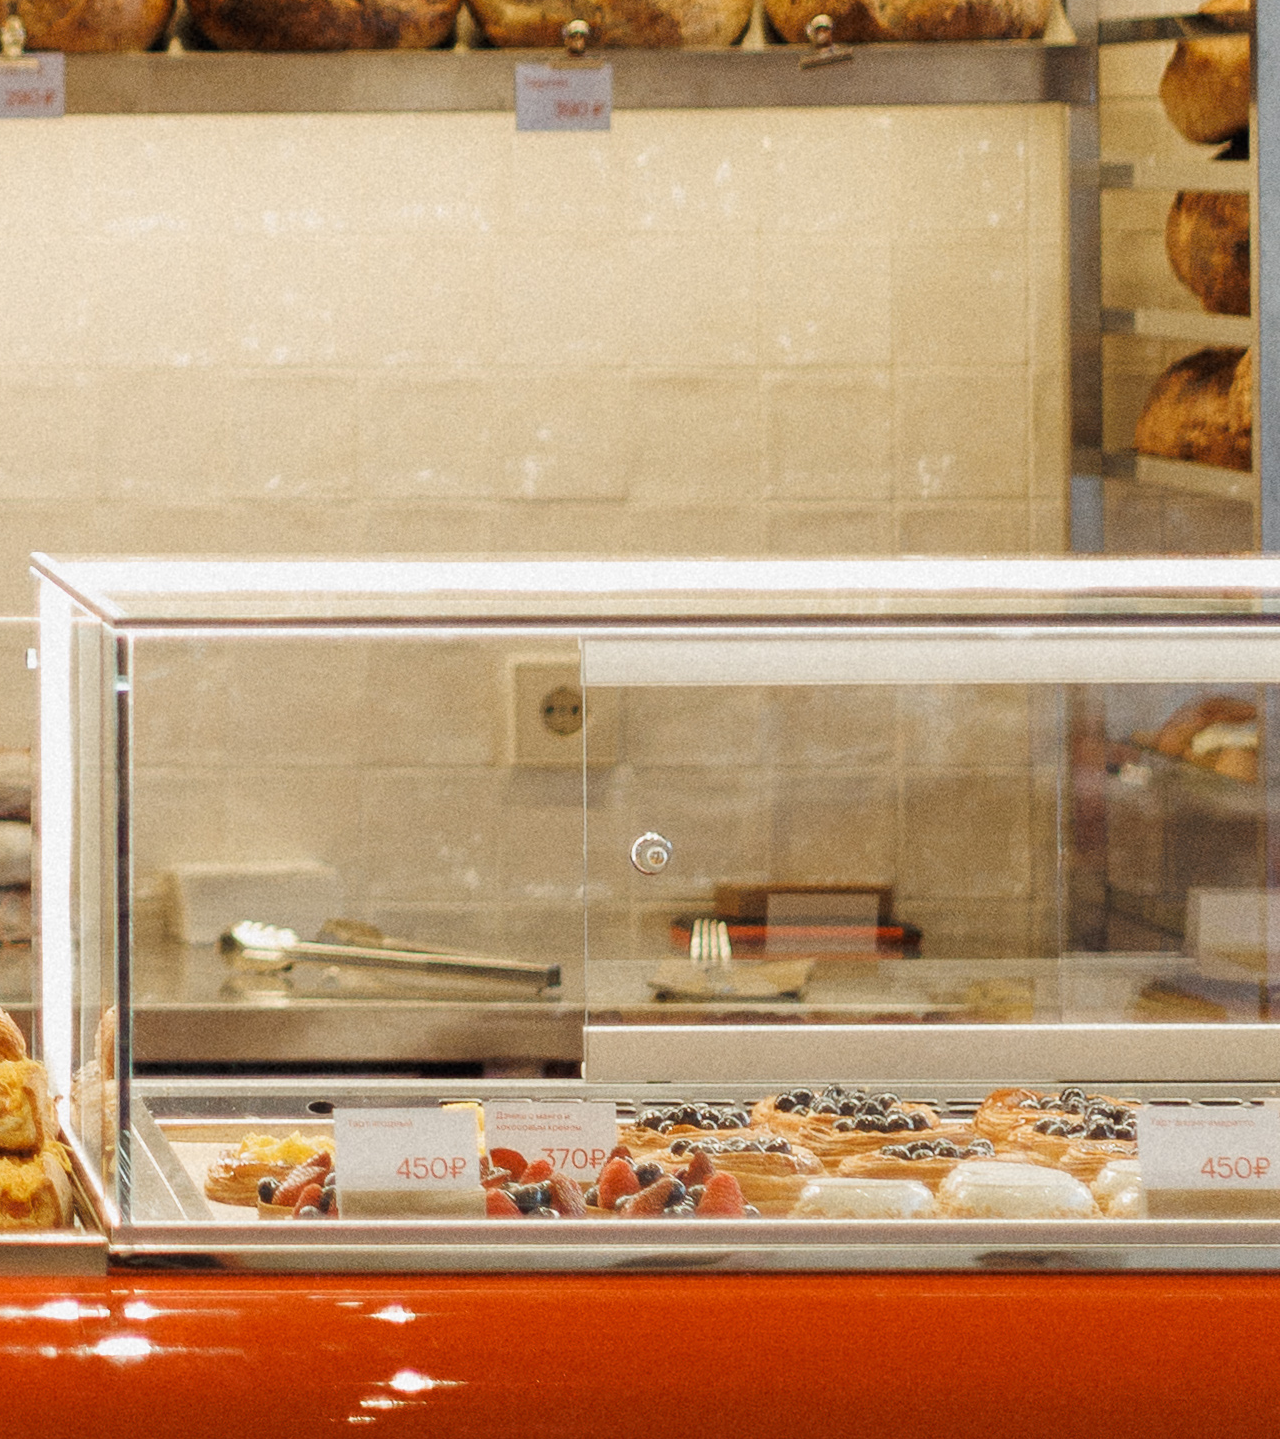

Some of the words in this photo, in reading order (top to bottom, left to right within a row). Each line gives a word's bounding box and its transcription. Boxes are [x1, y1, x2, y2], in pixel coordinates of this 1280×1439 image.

[395, 1156, 468, 1180] 450₽
[540, 1147, 607, 1170] 370₽
[1200, 1156, 1271, 1179] 450₽
